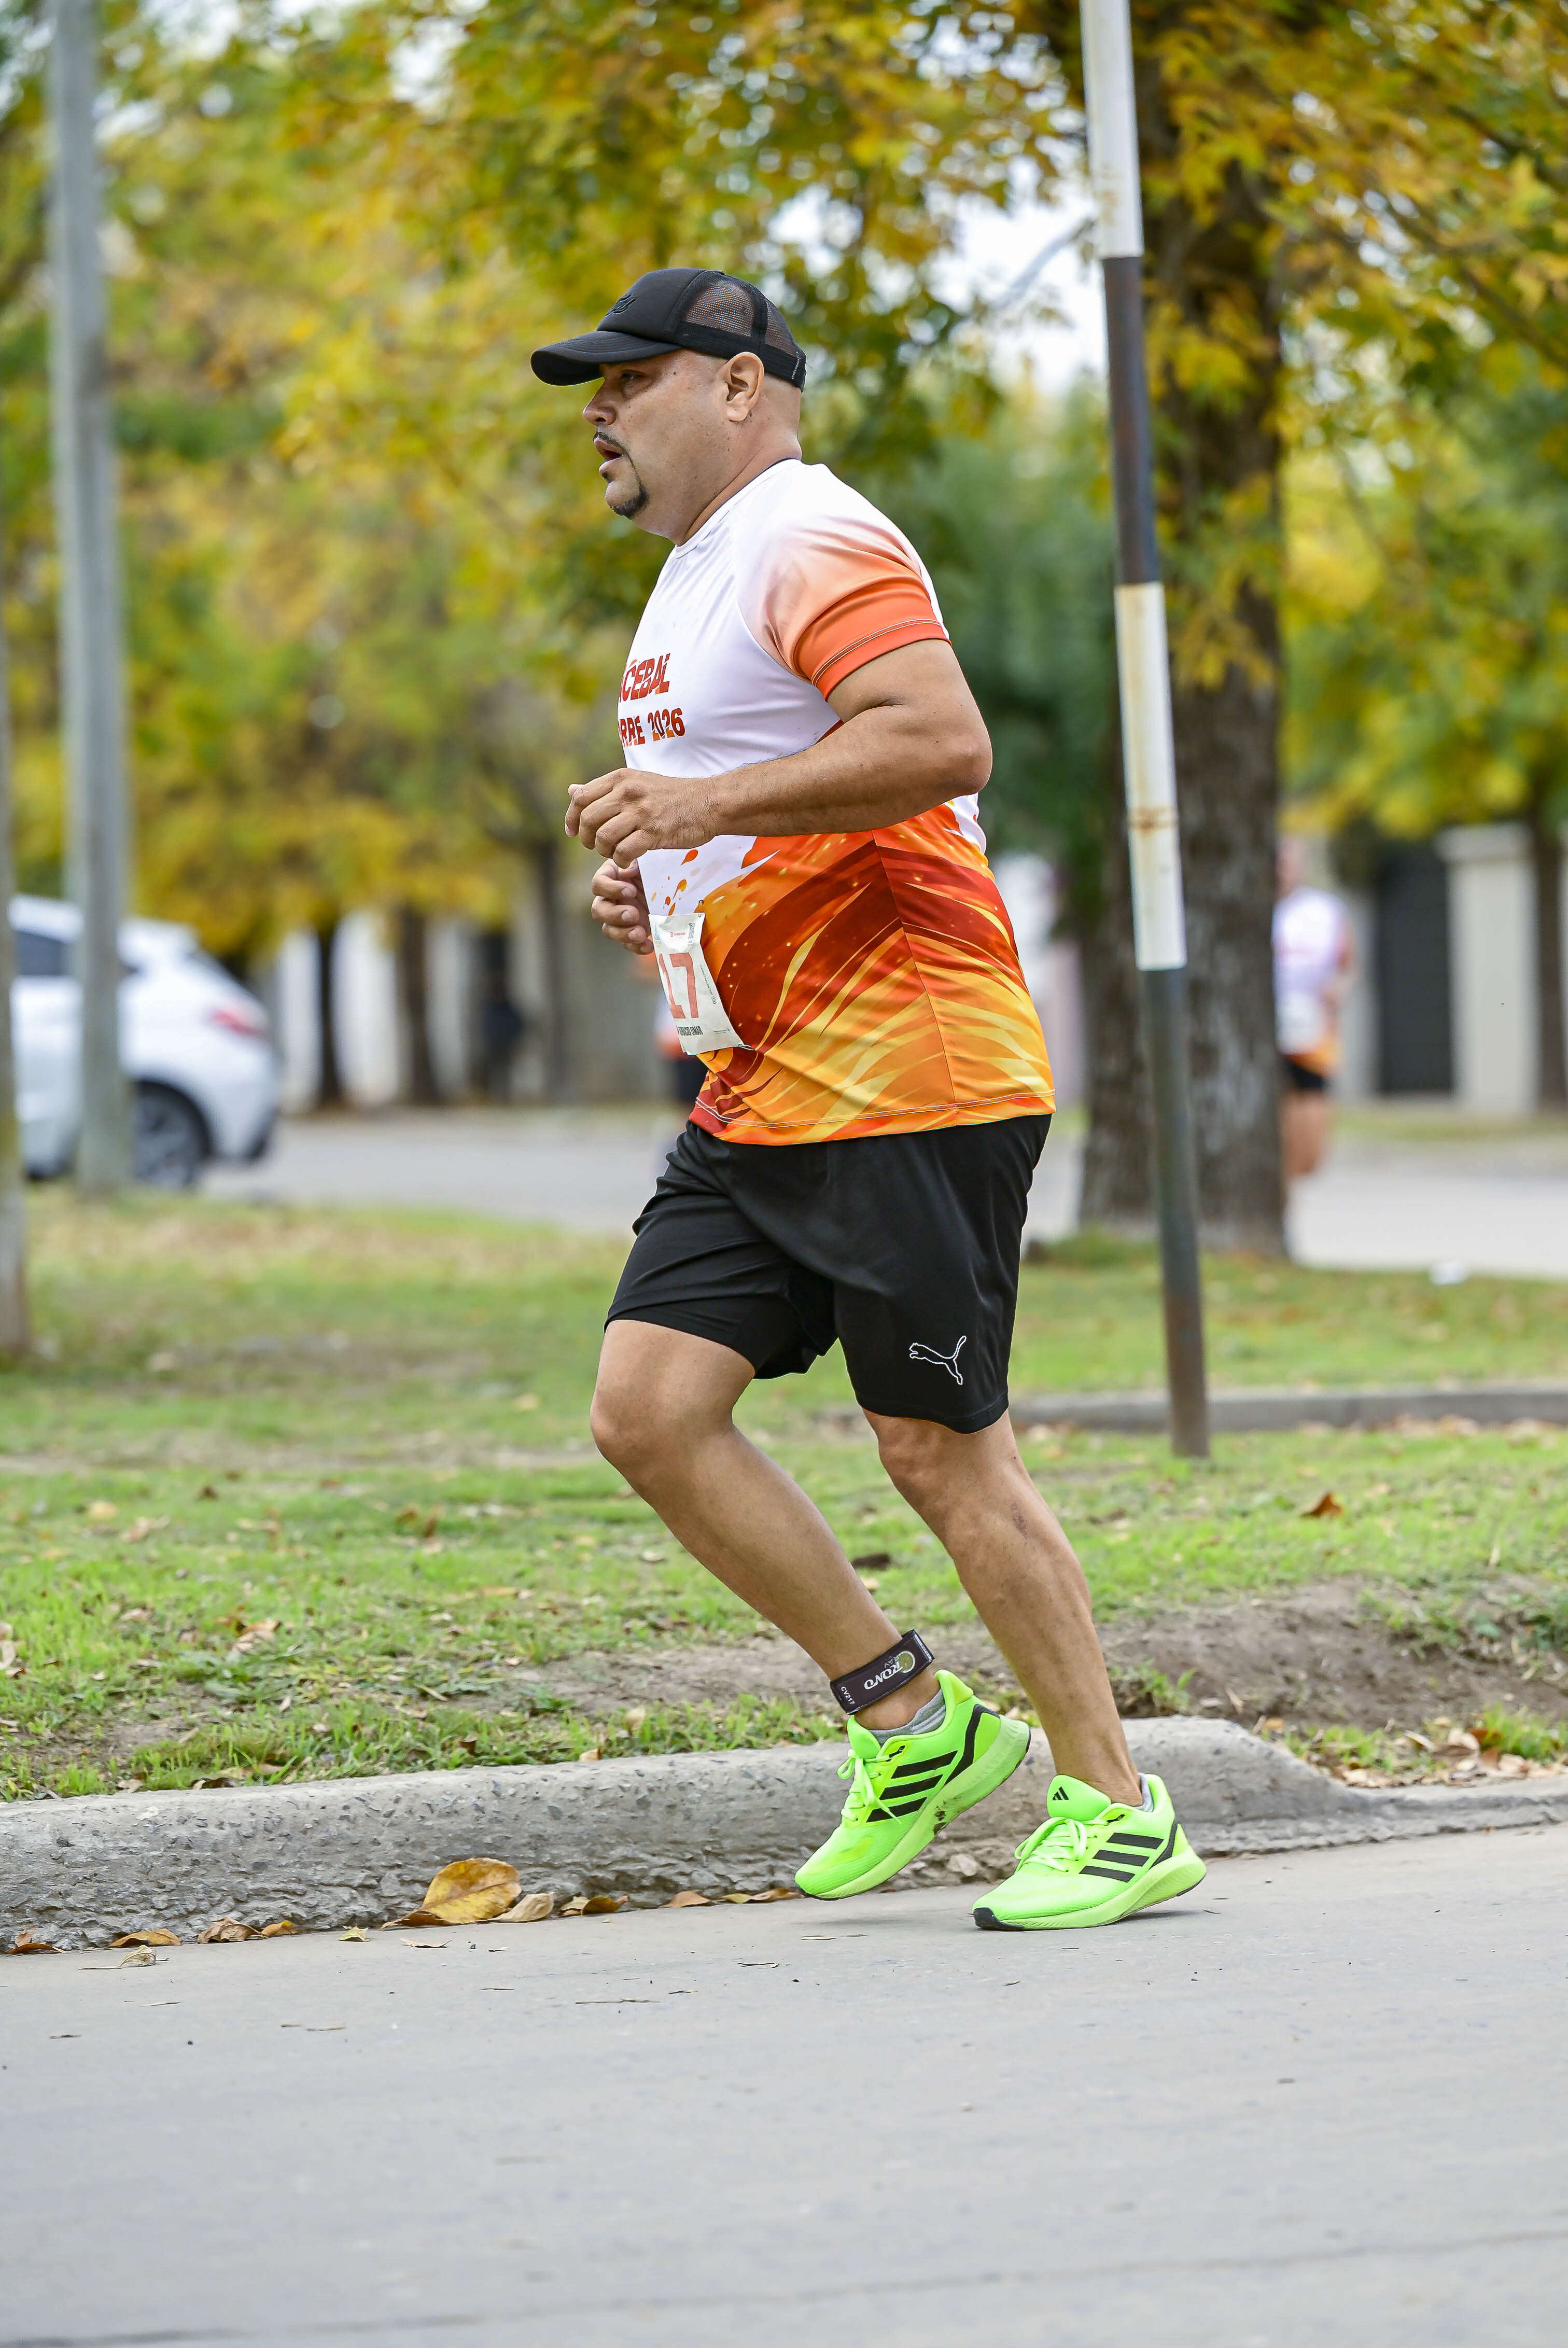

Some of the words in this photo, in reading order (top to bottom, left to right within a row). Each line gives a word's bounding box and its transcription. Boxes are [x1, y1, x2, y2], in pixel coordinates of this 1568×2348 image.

[619, 653, 671, 703] CEBAL
[648, 707, 685, 742] 2026
[841, 1686, 855, 1705] CV217
